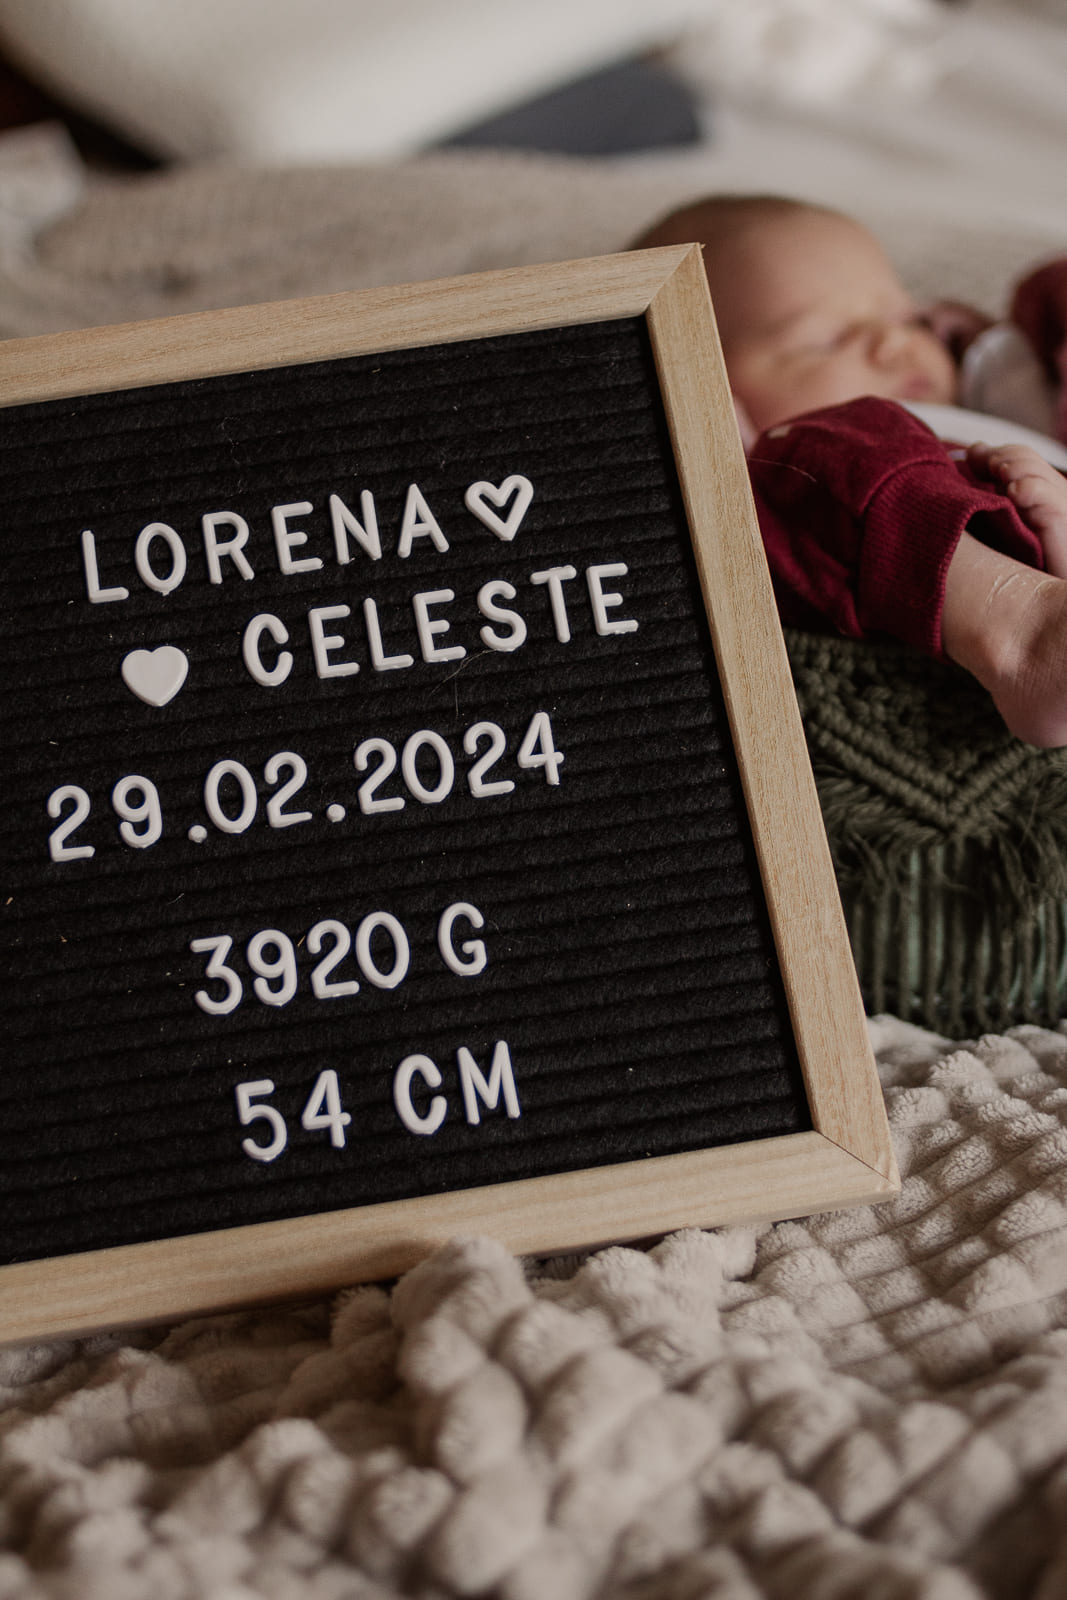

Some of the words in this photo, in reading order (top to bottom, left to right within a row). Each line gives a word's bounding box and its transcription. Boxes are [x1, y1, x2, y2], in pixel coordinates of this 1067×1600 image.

[82, 483, 451, 604] LORENA
[243, 562, 639, 687] CELESTE
[191, 911, 410, 1015] 3920
[438, 902, 488, 977] G
[236, 1069, 352, 1162] 54
[394, 1040, 521, 1135] CM
